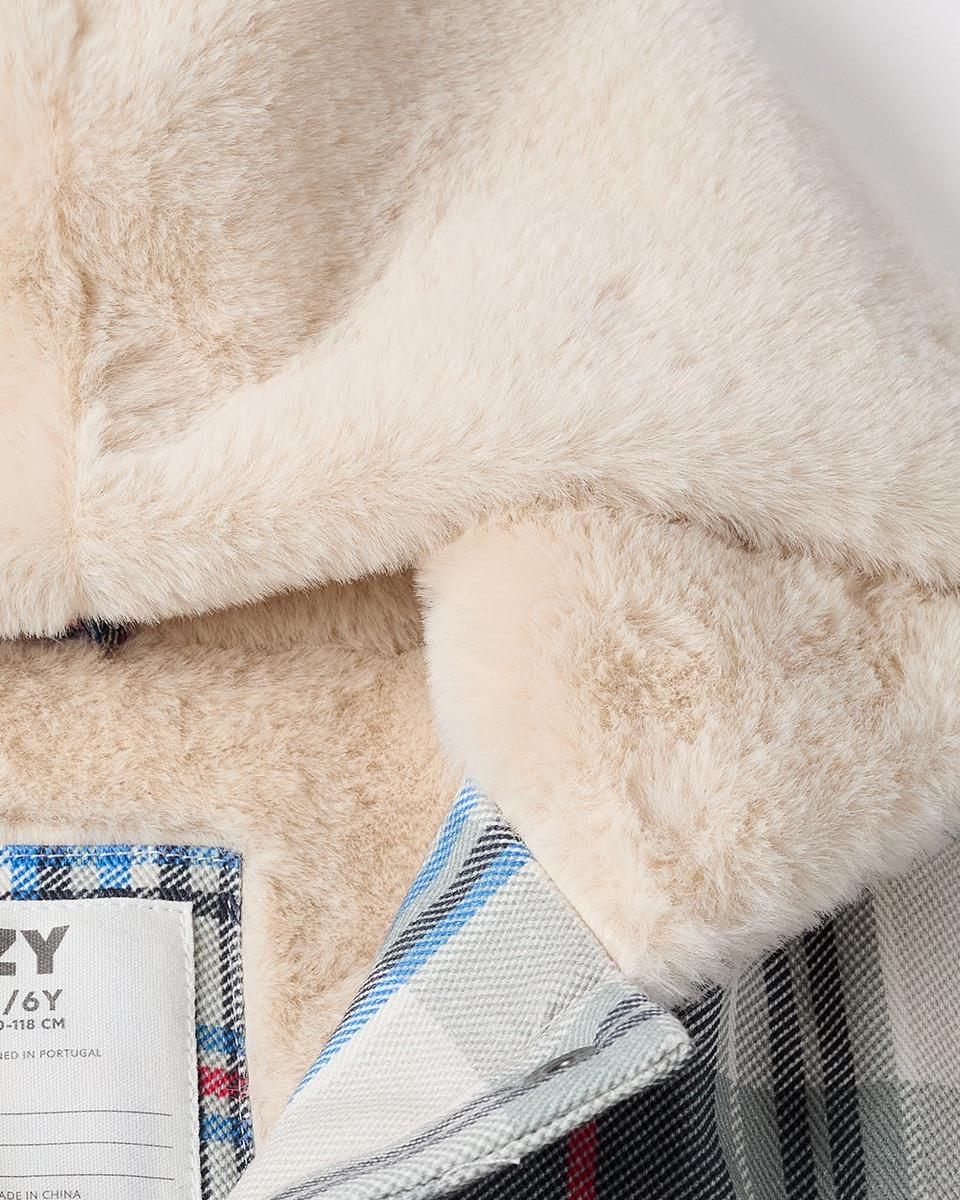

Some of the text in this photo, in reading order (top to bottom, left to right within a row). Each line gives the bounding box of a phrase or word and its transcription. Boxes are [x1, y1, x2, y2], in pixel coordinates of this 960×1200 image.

[42, 1018, 65, 1030] CM
[23, 1050, 35, 1059] IN
[40, 1049, 101, 1059] PORTUGAL
[26, 1191, 38, 1200] IN
[42, 1190, 81, 1200] CHINA
